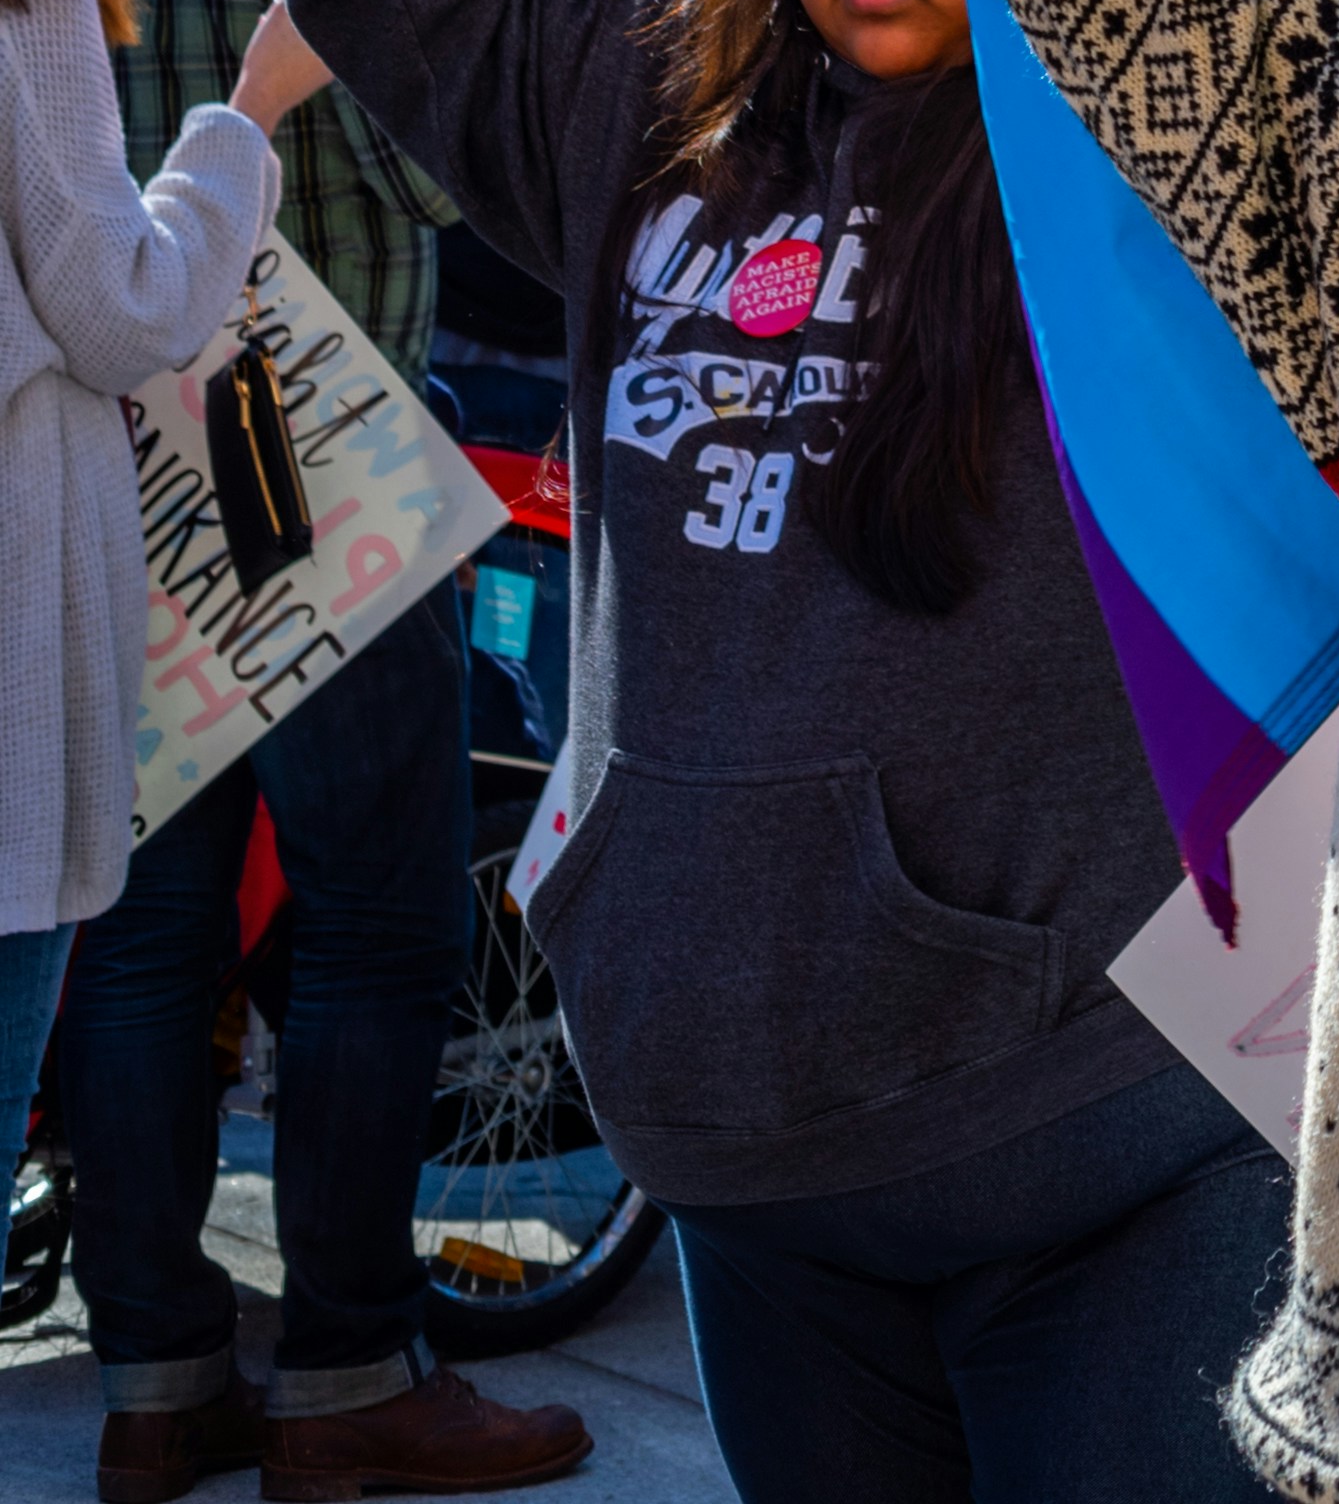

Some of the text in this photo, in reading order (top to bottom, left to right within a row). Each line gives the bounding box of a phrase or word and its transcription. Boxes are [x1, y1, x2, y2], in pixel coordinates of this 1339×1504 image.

[732, 262, 822, 298] RACISTS
[745, 252, 810, 279] MAKE
[735, 277, 819, 310] AFRAID
[740, 291, 812, 323] AGAIN
[683, 443, 796, 555] 38
